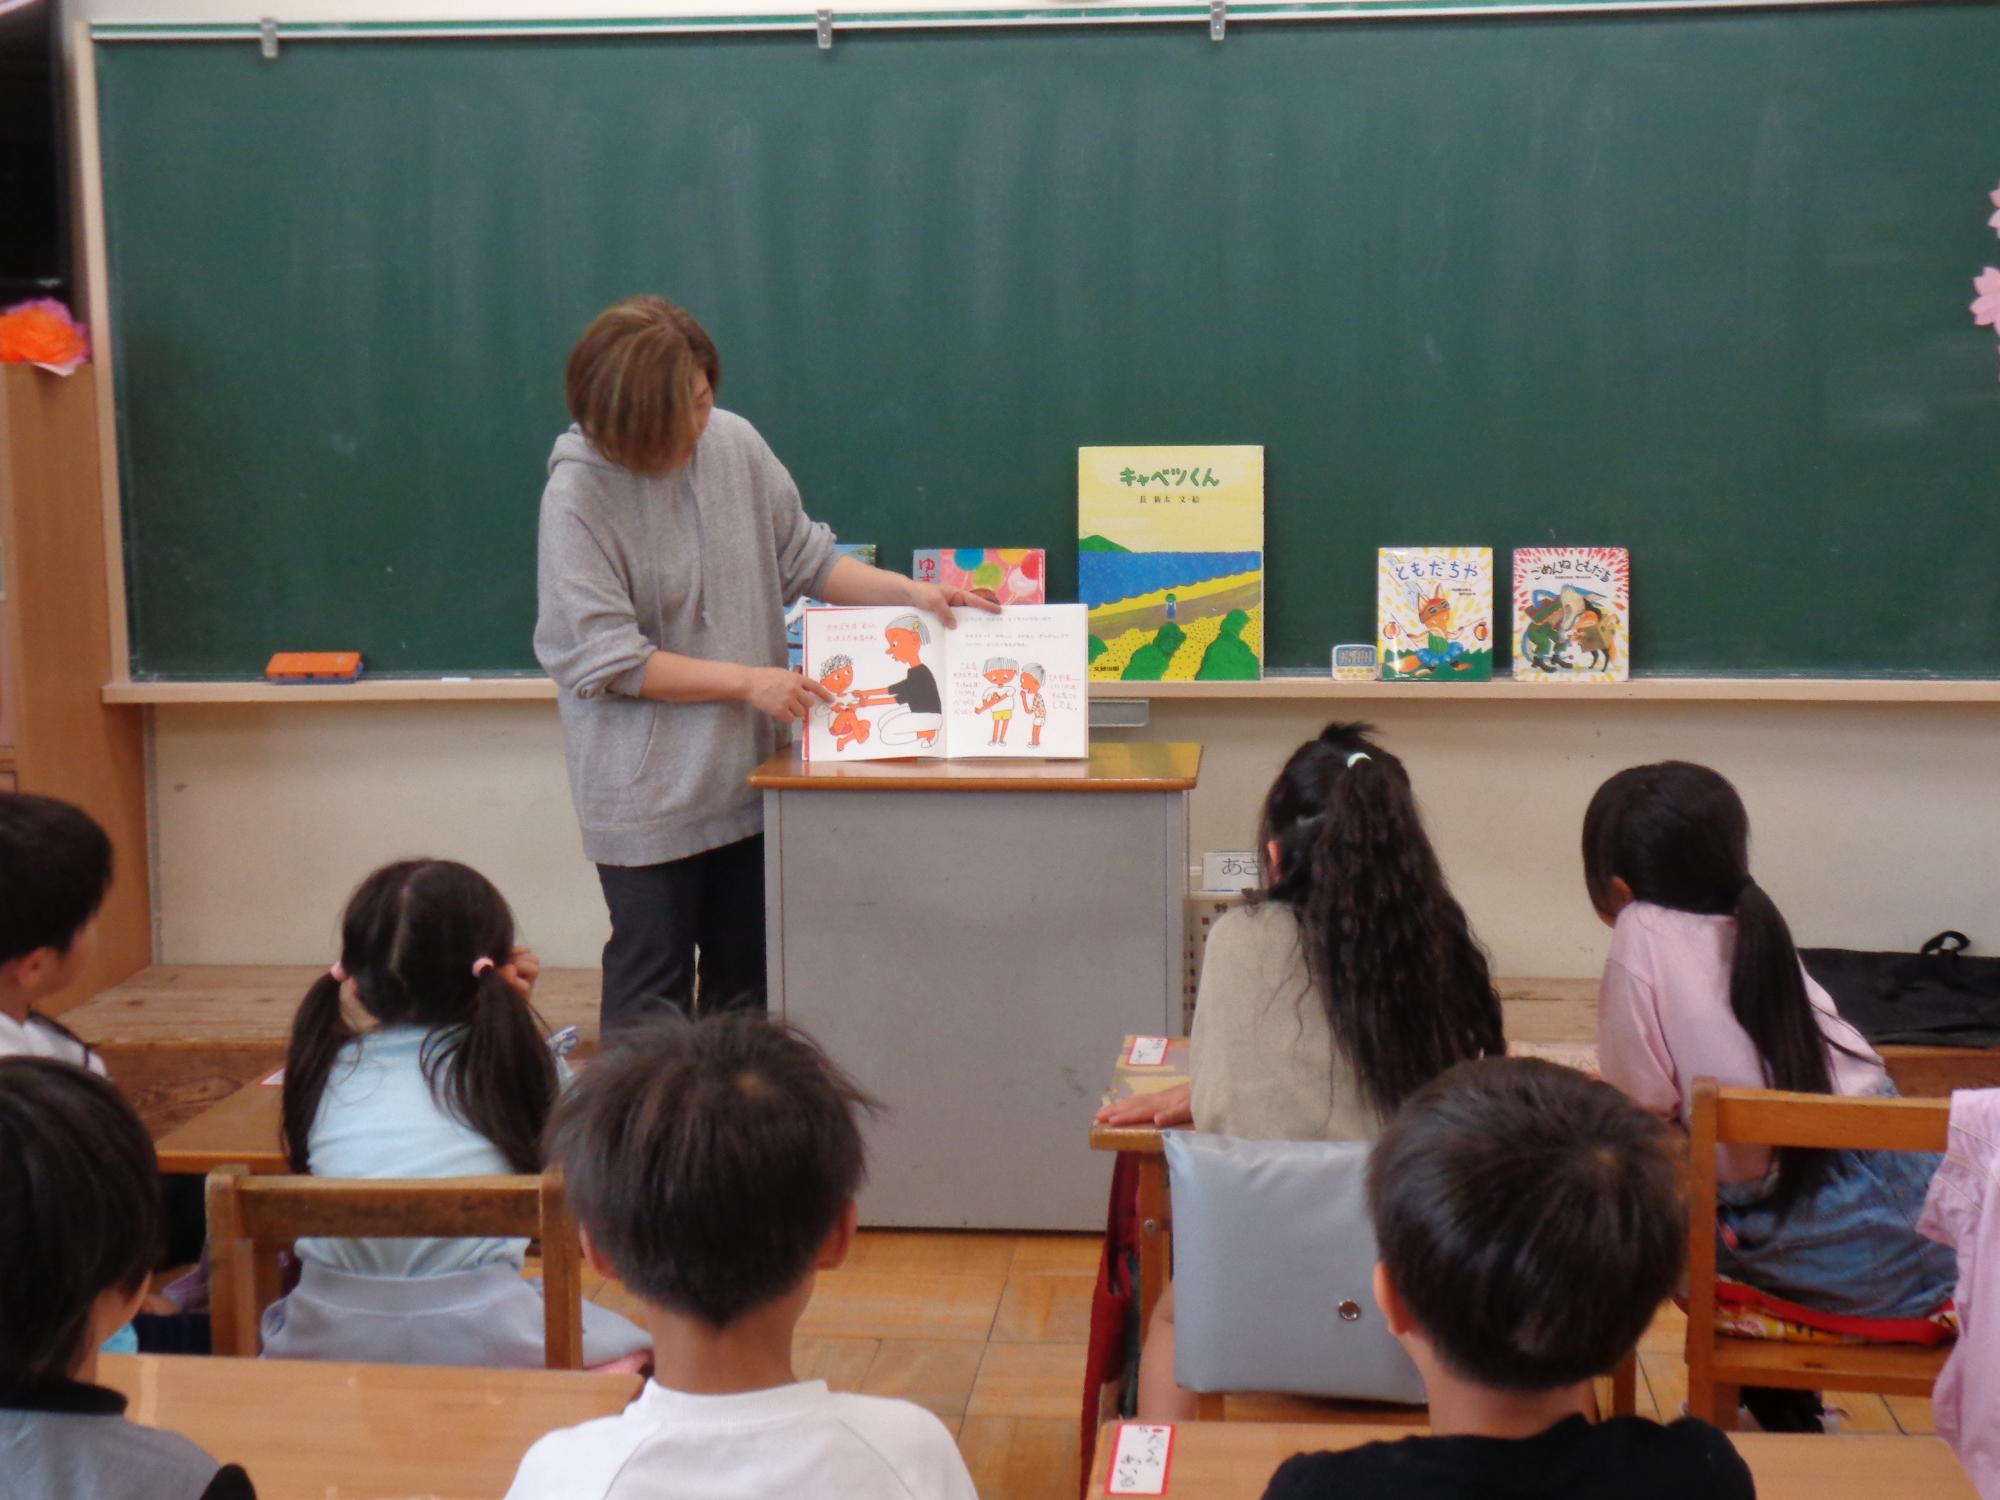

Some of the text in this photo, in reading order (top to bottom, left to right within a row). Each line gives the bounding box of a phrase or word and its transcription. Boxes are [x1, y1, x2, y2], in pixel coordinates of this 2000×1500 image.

[1119, 467, 1220, 487] キャベツくん
[1395, 560, 1478, 580] ともだちや
[1530, 559, 1611, 583] ごめんね ともだち
